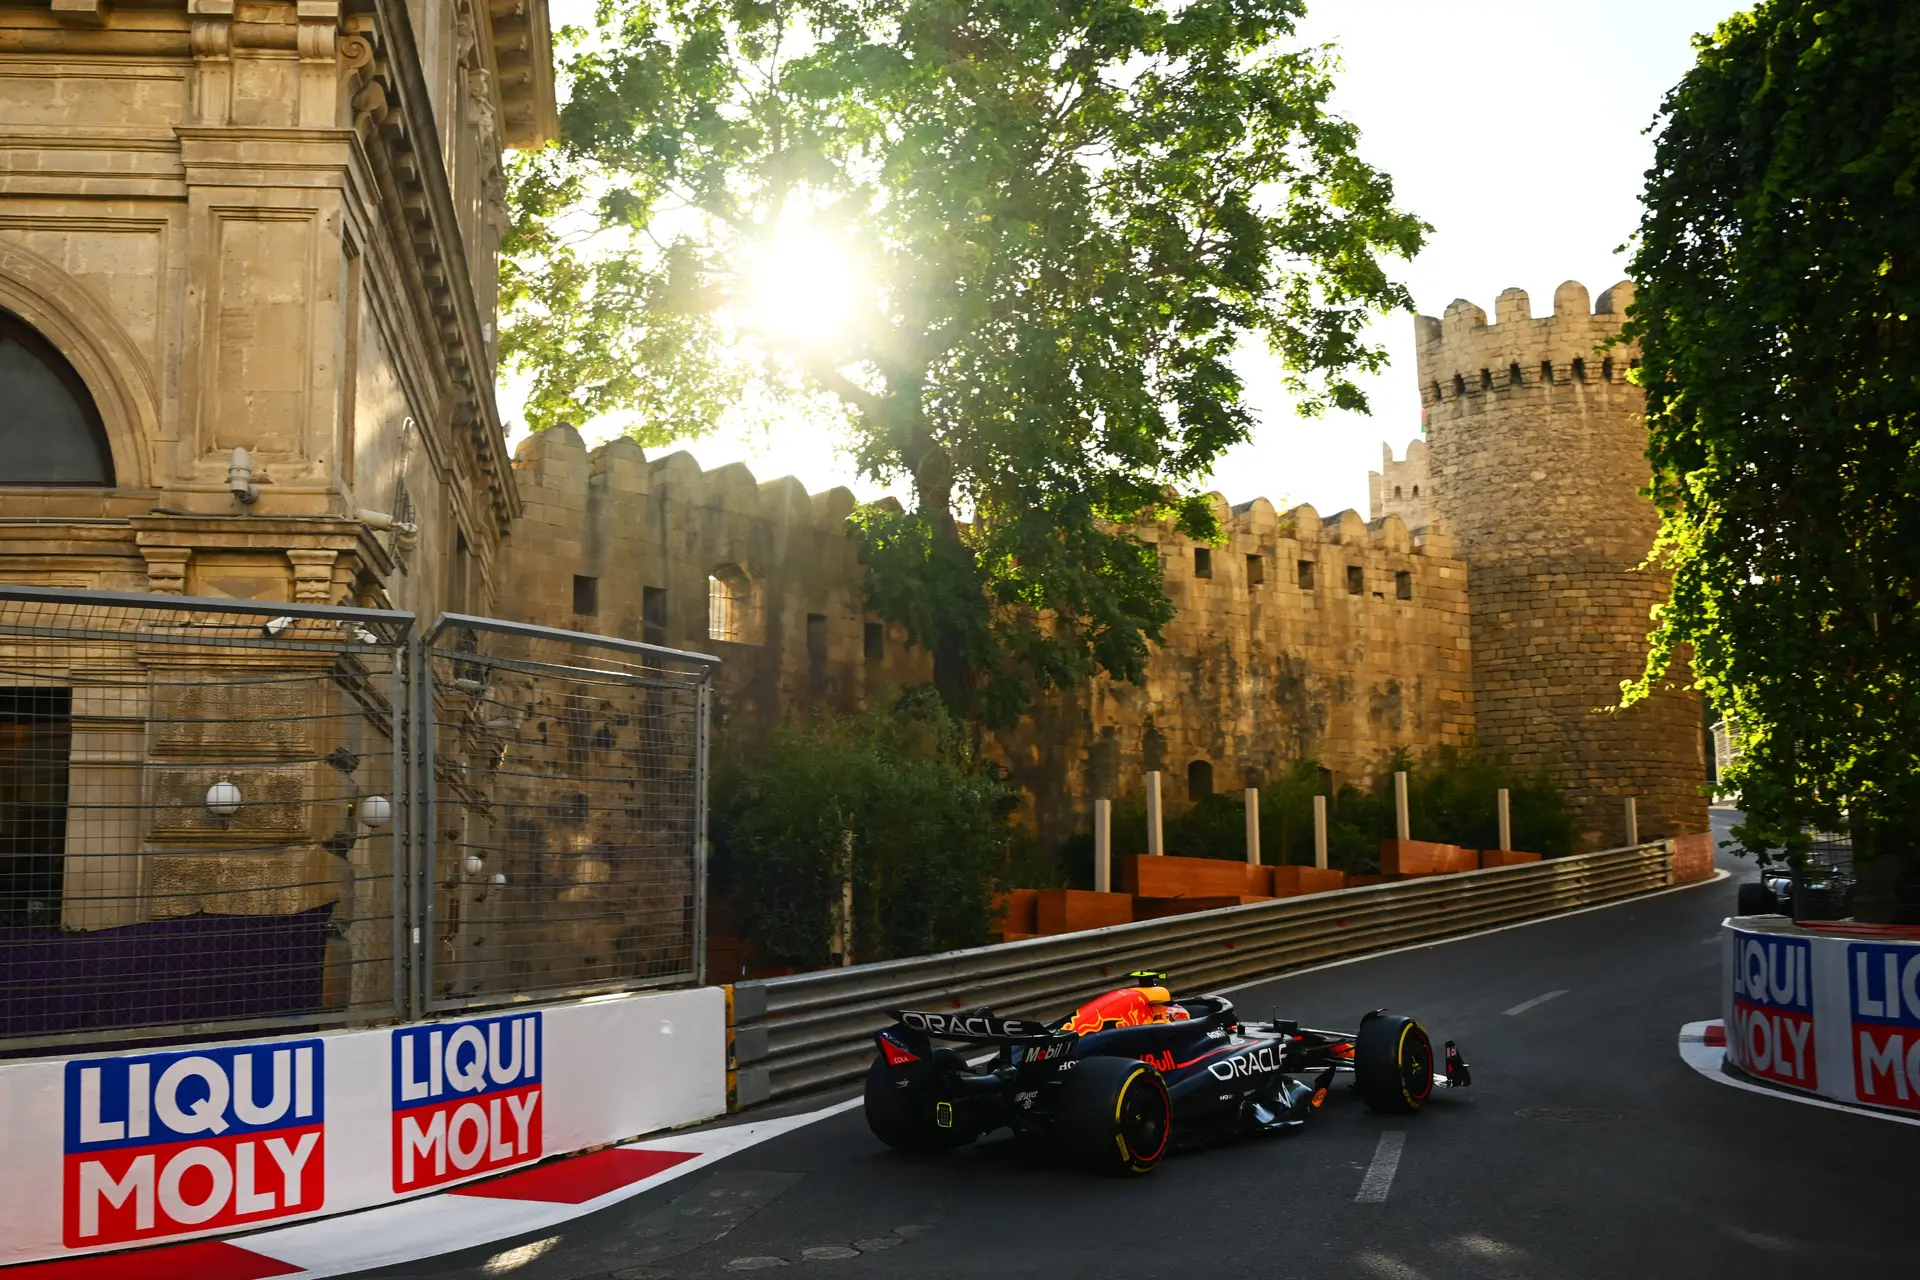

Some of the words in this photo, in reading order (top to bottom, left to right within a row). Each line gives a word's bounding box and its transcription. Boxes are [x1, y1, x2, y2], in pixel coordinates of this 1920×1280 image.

[1735, 935, 1807, 1007] LIQUI
[401, 1016, 536, 1100] LIQUI
[902, 1012, 1023, 1036] ORACLE
[1025, 1042, 1064, 1063] Mobil
[1734, 1005, 1812, 1081] MOLY
[80, 1046, 314, 1144] LIQUI
[401, 1091, 540, 1184] MOLY
[79, 1132, 320, 1238] MOLY
